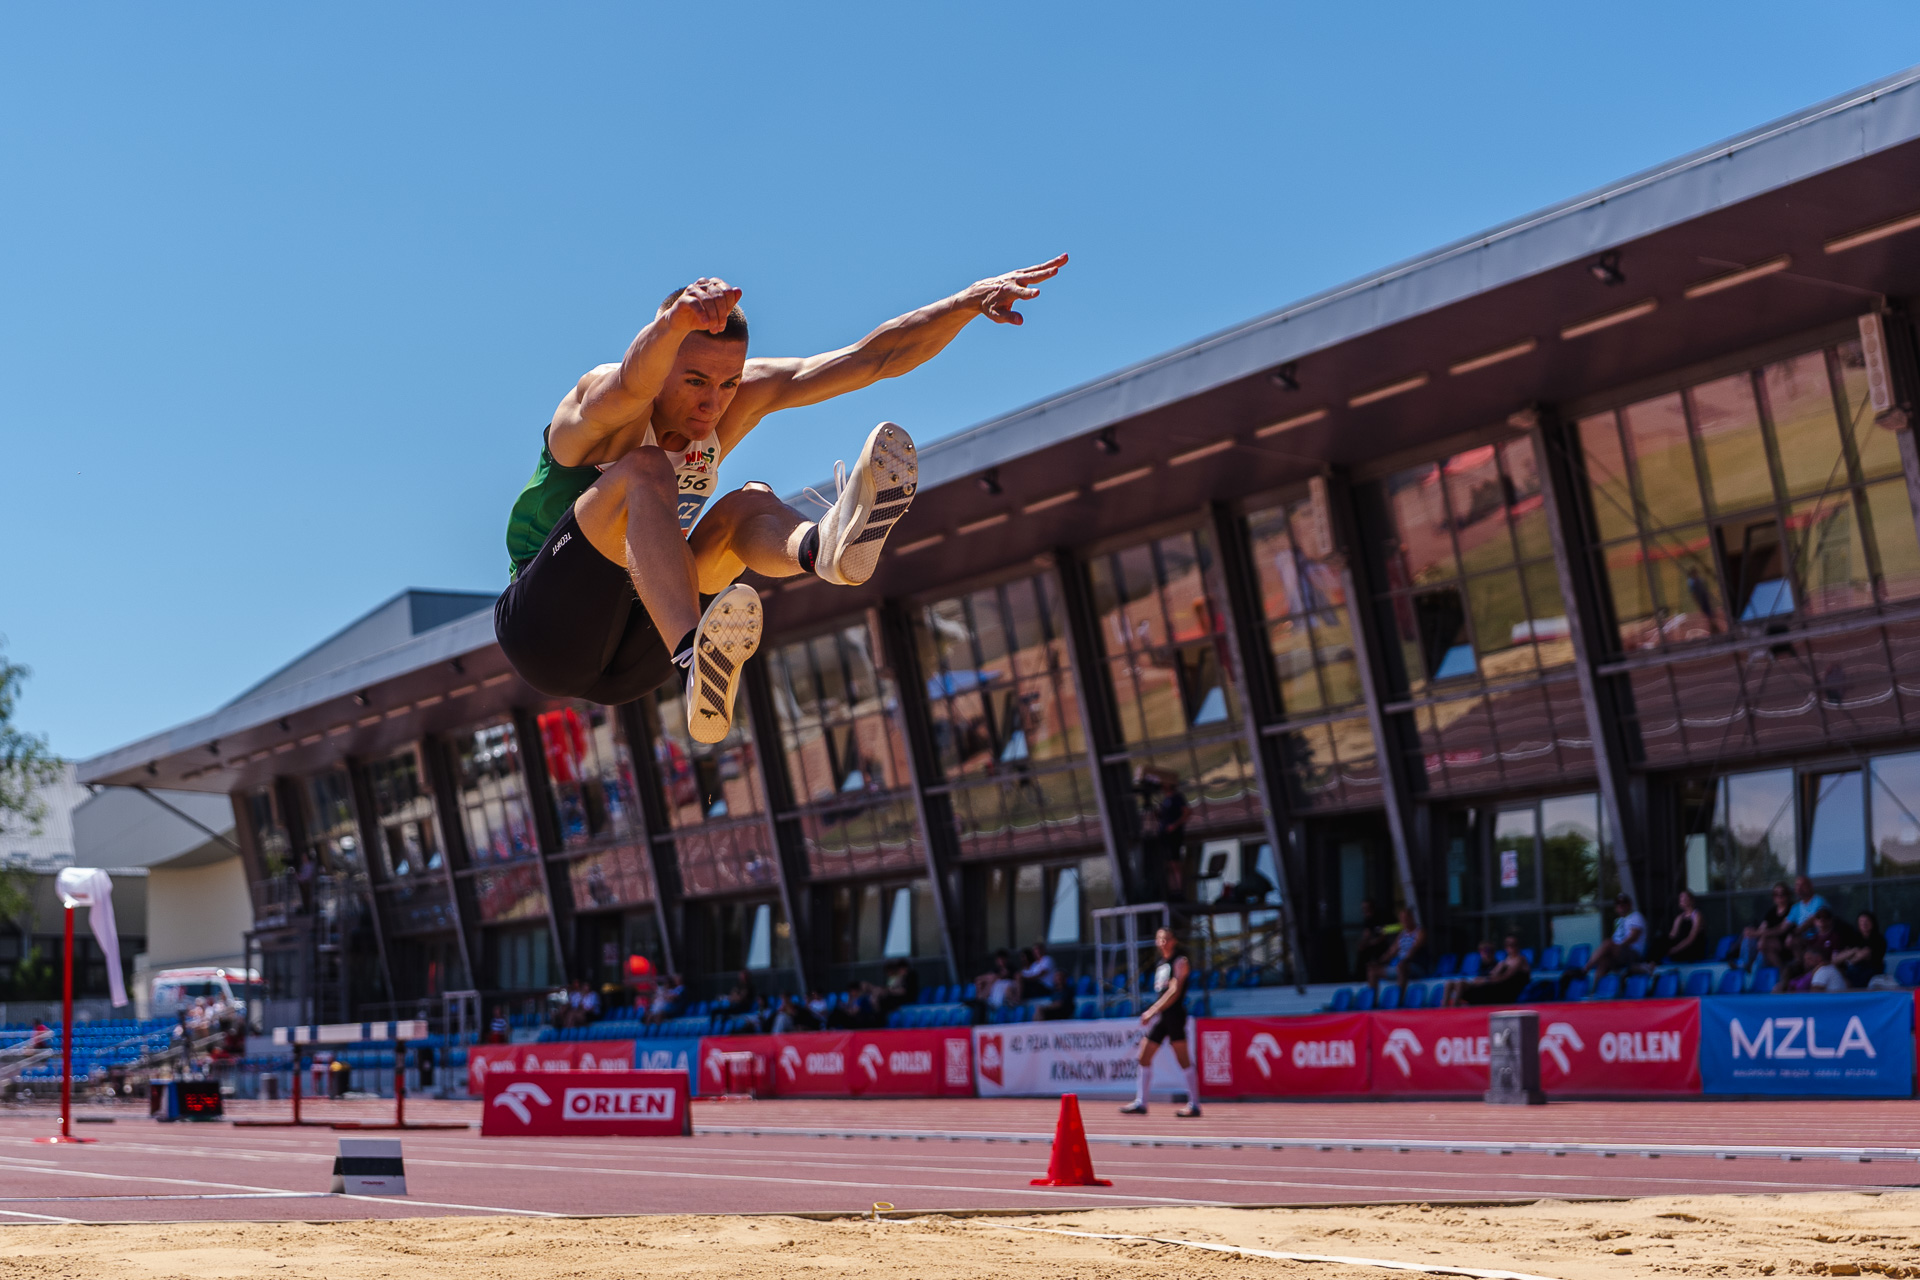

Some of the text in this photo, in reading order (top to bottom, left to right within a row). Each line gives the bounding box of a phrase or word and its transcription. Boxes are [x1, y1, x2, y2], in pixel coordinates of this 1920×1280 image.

[1435, 1036, 1490, 1066] ORLE
[1599, 1031, 1681, 1063] ORLEN
[1729, 1015, 1877, 1059] MZLA
[806, 1052, 844, 1075] ORLEN
[889, 1050, 932, 1075] ORLEN
[1051, 1053, 1106, 1080] KRAKÓW
[1291, 1040, 1356, 1069] ORLEN
[571, 1093, 667, 1114] ORLEN
